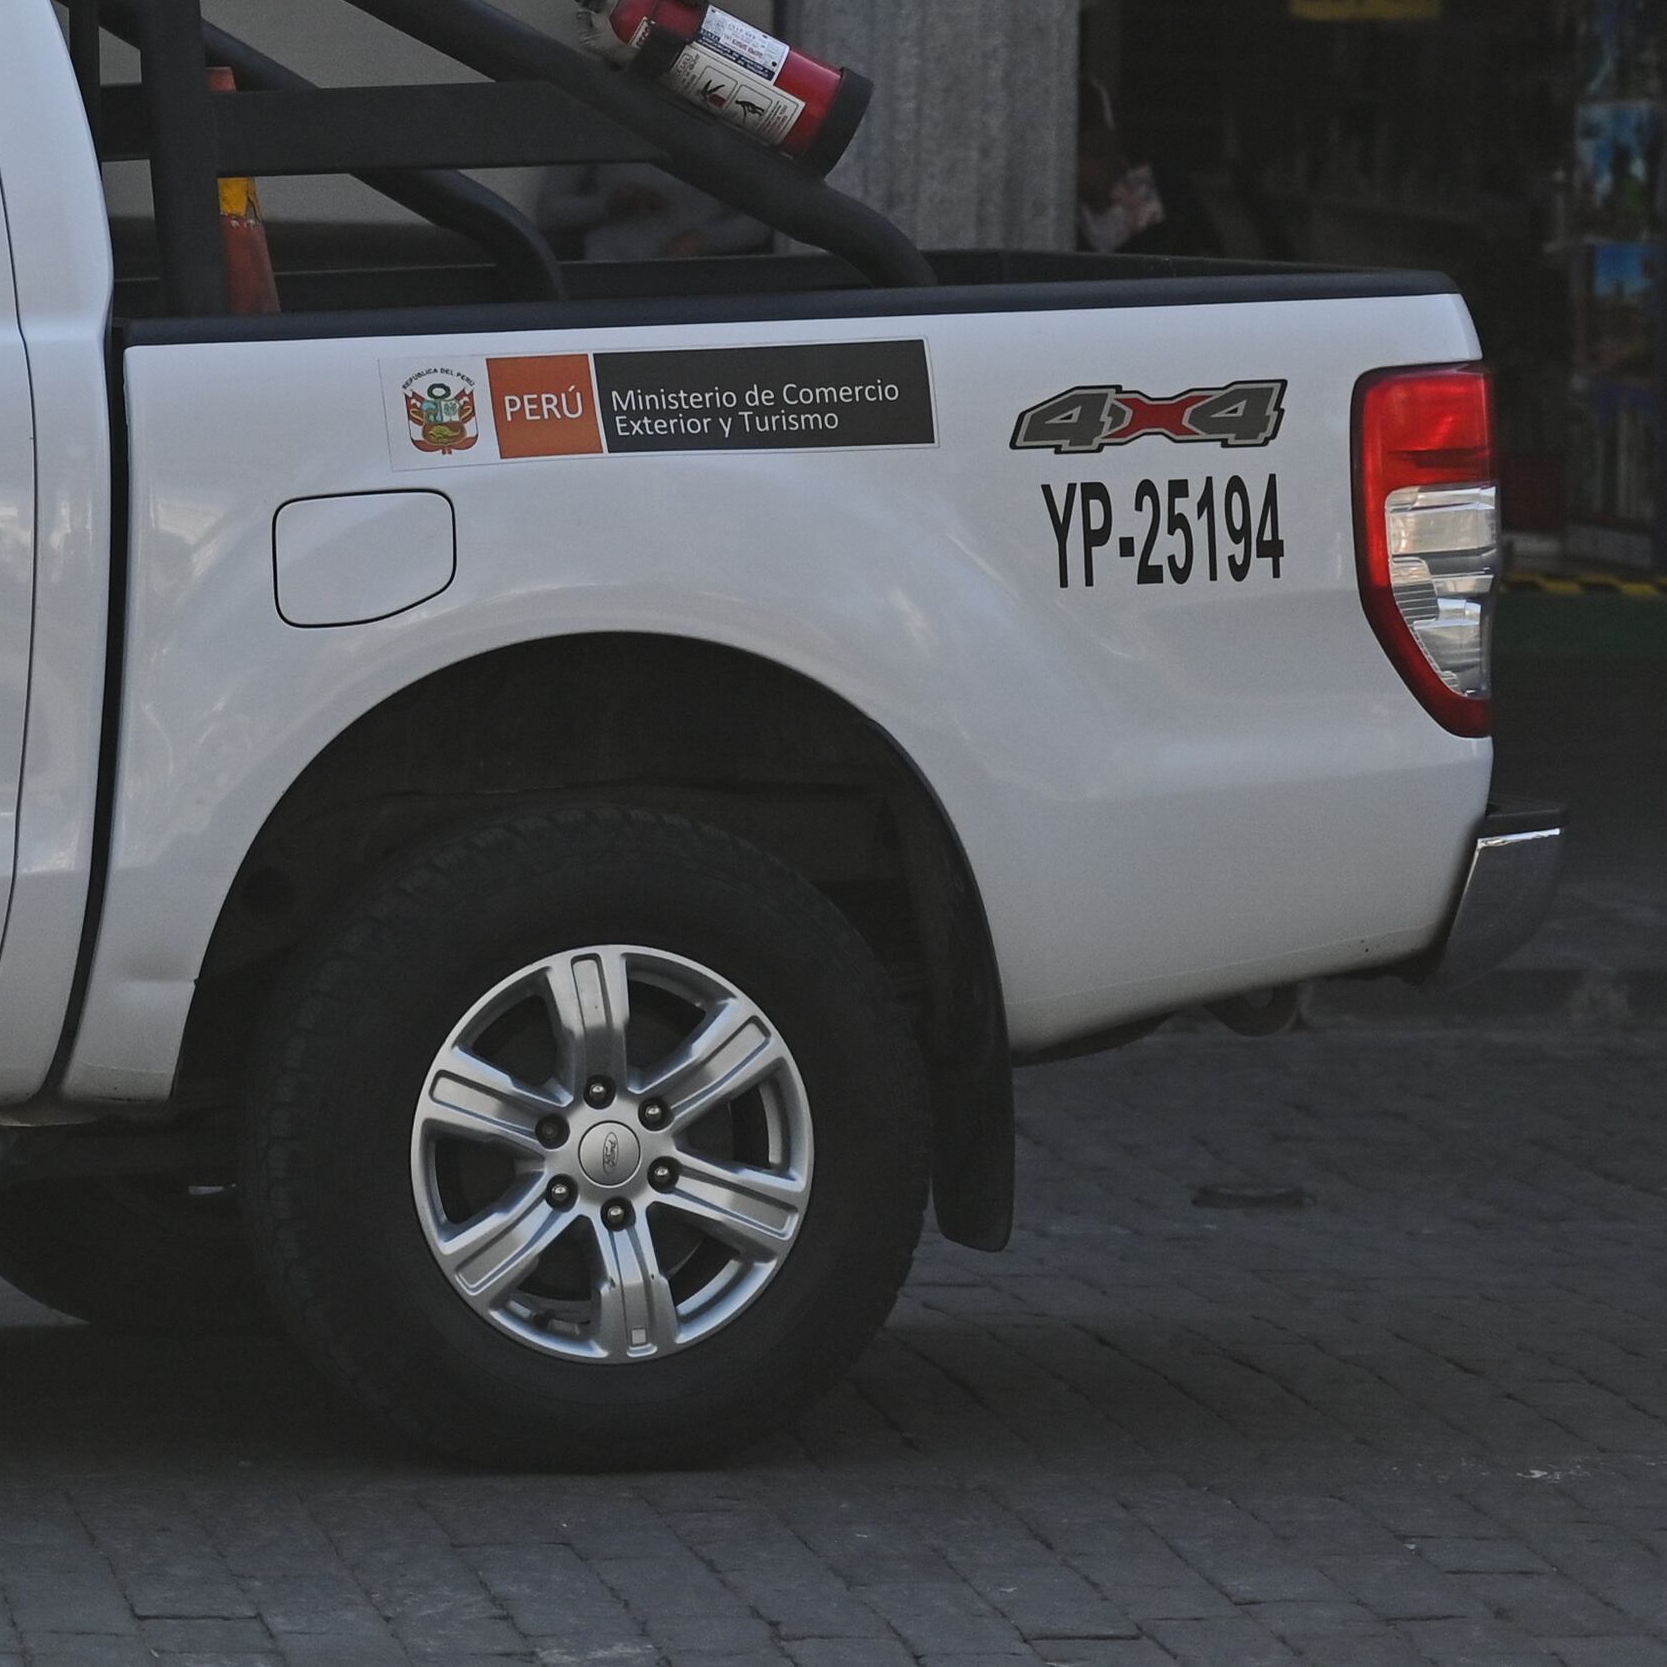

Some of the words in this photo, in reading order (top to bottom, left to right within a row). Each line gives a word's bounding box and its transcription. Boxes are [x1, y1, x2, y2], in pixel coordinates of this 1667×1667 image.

[440, 367, 454, 376] DEL
[503, 385, 584, 422] PERÚ
[610, 386, 738, 412] Ministerio
[744, 383, 776, 406] de
[781, 378, 900, 406] Comercio
[614, 413, 712, 437] Exterior
[720, 415, 734, 438] y
[738, 410, 840, 433] Turismo
[1039, 472, 1286, 589] YP-25194
